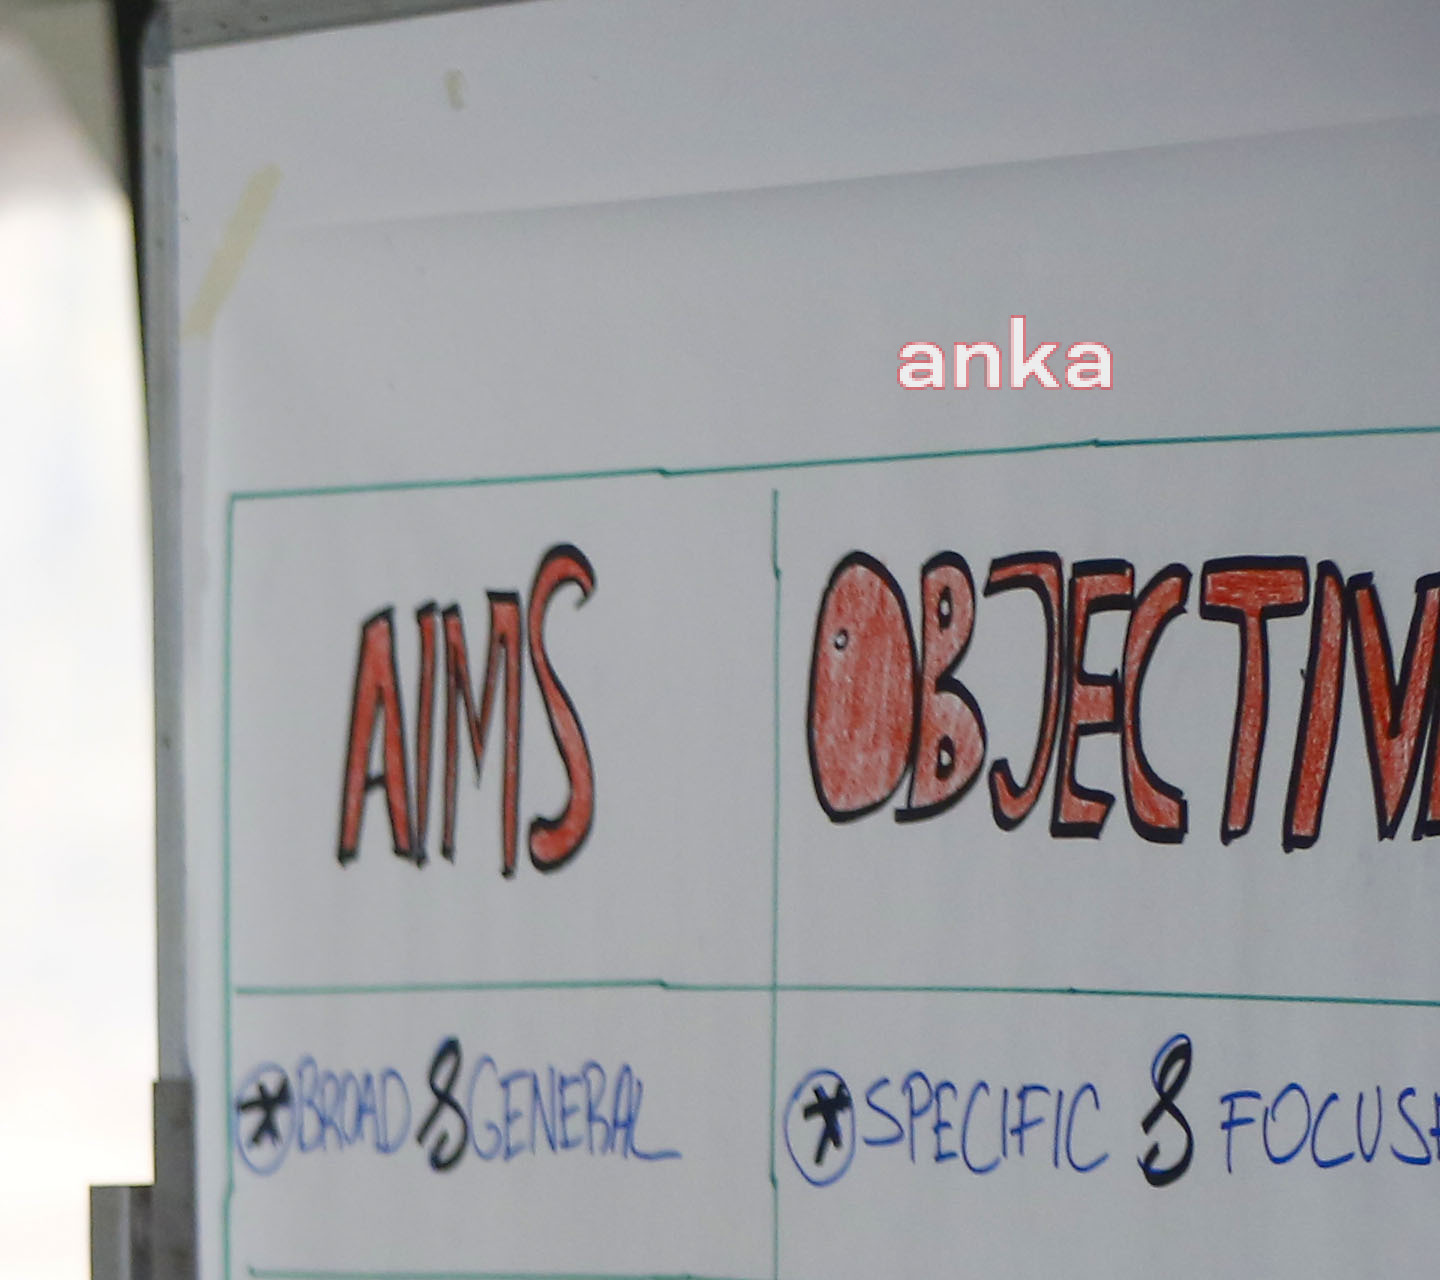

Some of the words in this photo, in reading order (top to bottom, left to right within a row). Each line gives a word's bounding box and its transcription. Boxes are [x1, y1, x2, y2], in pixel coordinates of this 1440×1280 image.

[336, 544, 597, 876] AIMS
[297, 1056, 412, 1154] BROAD
[467, 1055, 682, 1162] GENERAL
[864, 1070, 1109, 1175] SPECIFIC
